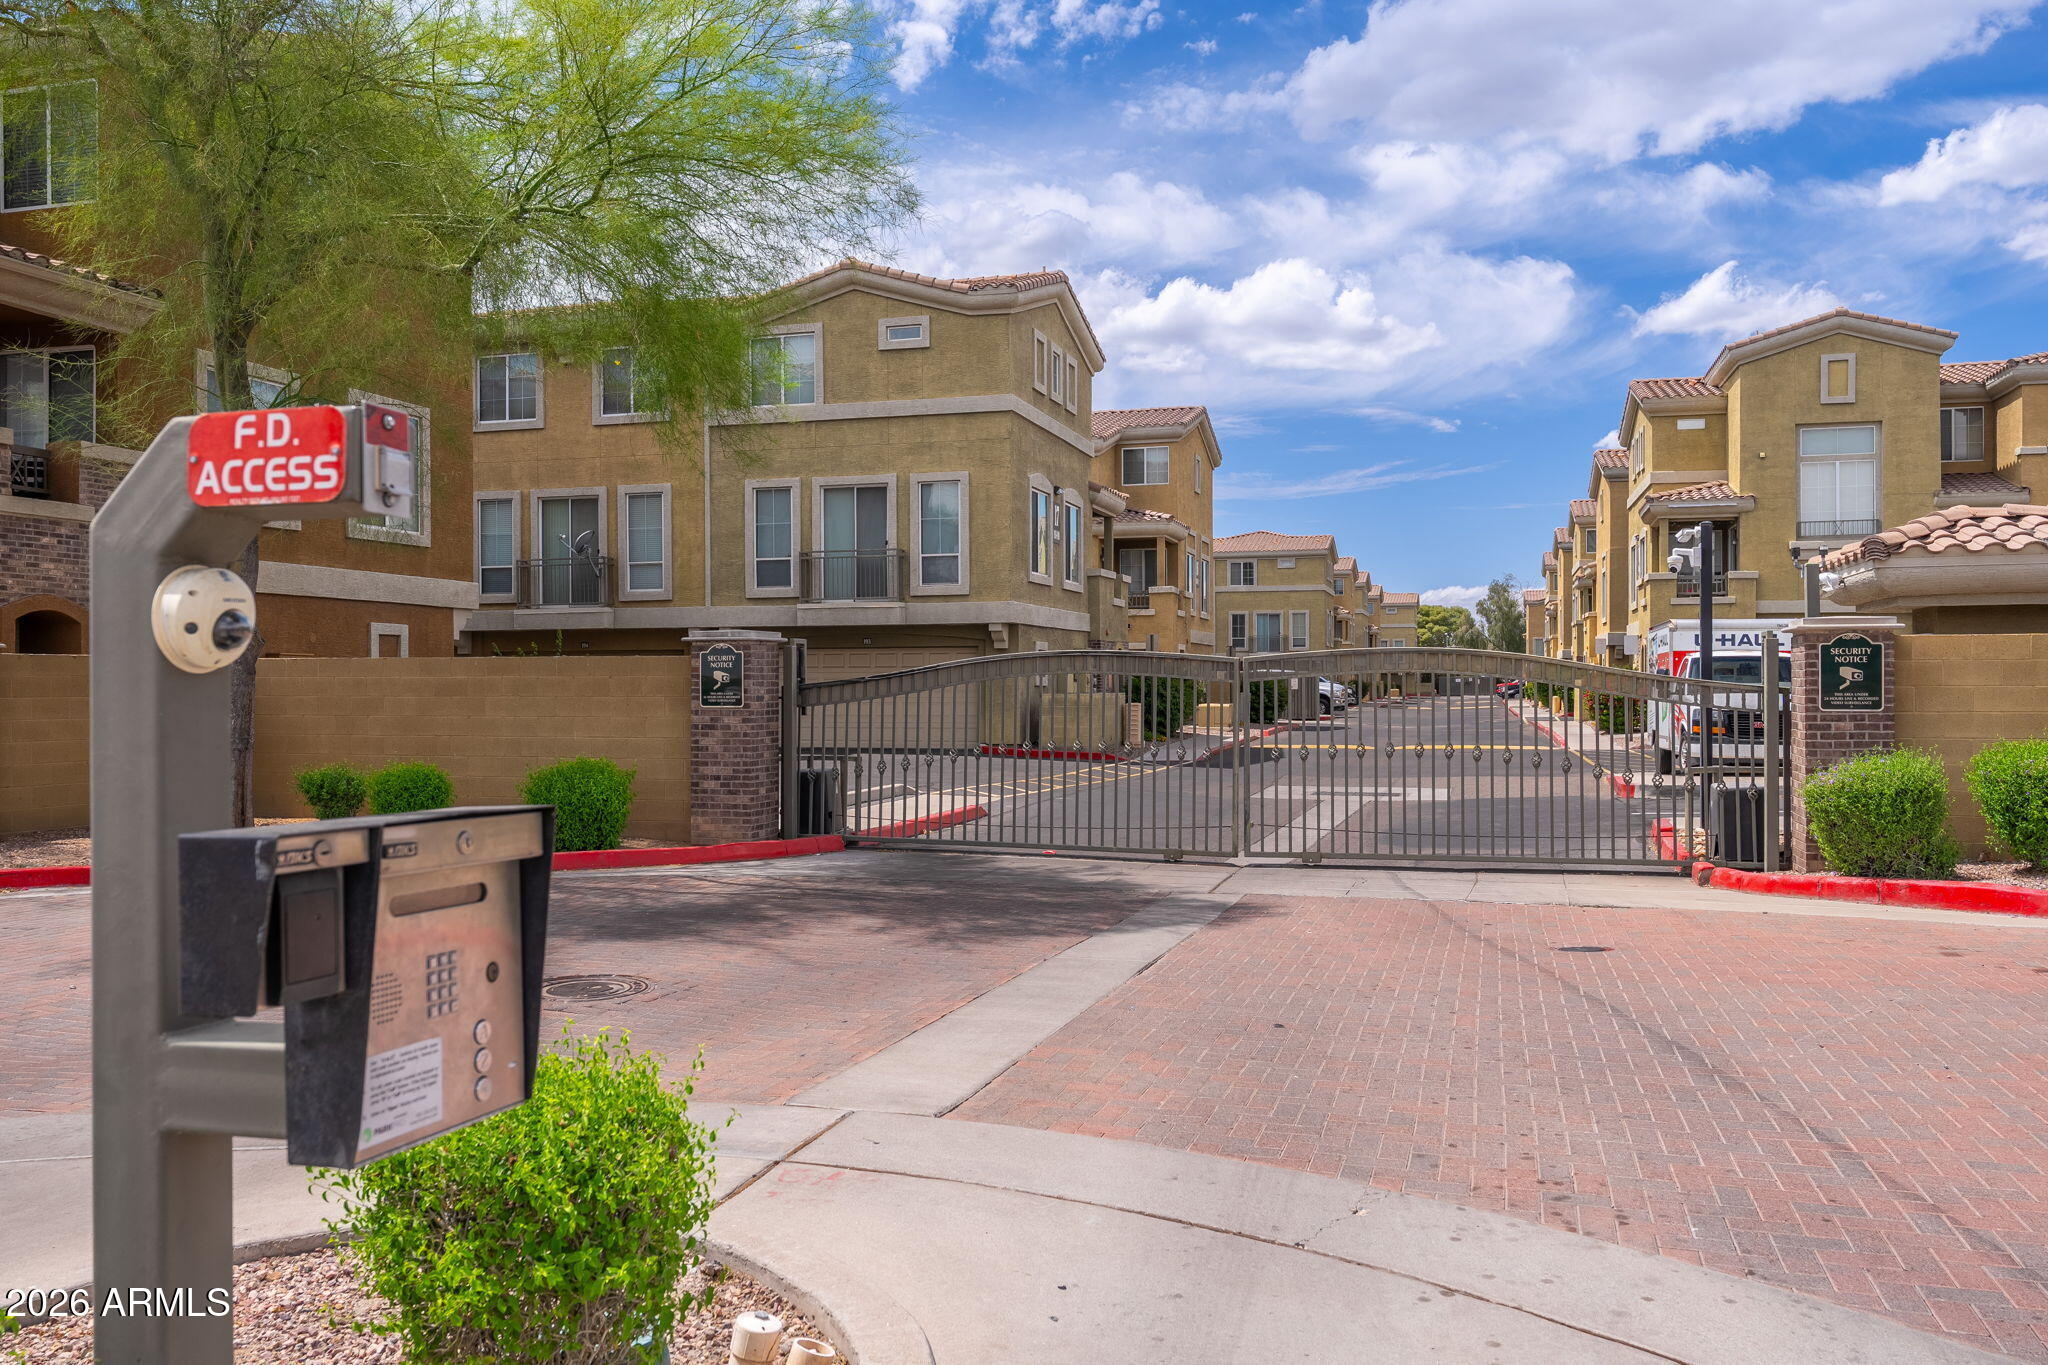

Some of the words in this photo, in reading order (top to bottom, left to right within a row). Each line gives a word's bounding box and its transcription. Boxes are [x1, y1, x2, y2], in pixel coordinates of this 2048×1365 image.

[234, 412, 300, 449] F.D.
[195, 454, 339, 495] ACCESS
[1830, 647, 1872, 655] SECURITY
